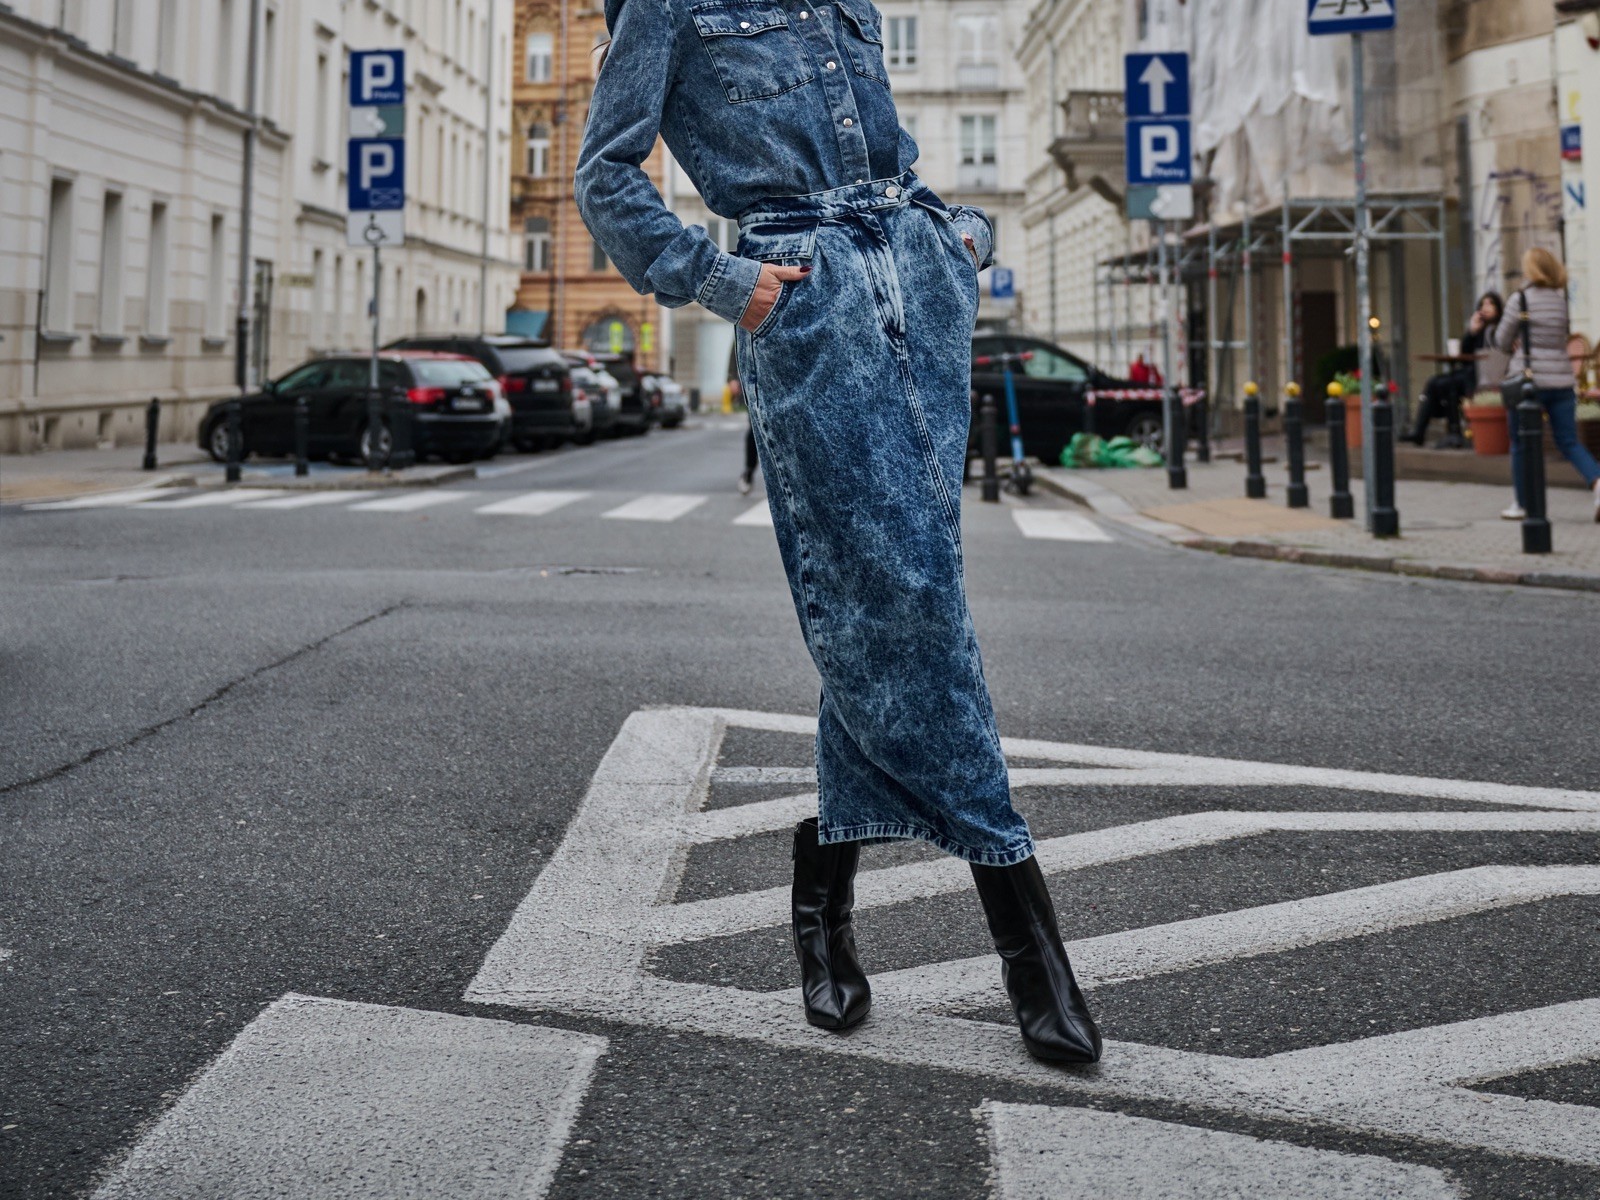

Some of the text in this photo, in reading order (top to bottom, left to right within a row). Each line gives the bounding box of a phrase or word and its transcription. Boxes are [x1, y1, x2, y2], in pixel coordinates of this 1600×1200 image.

[362, 55, 394, 101] P
[360, 143, 394, 189] P
[1139, 124, 1179, 178] P
